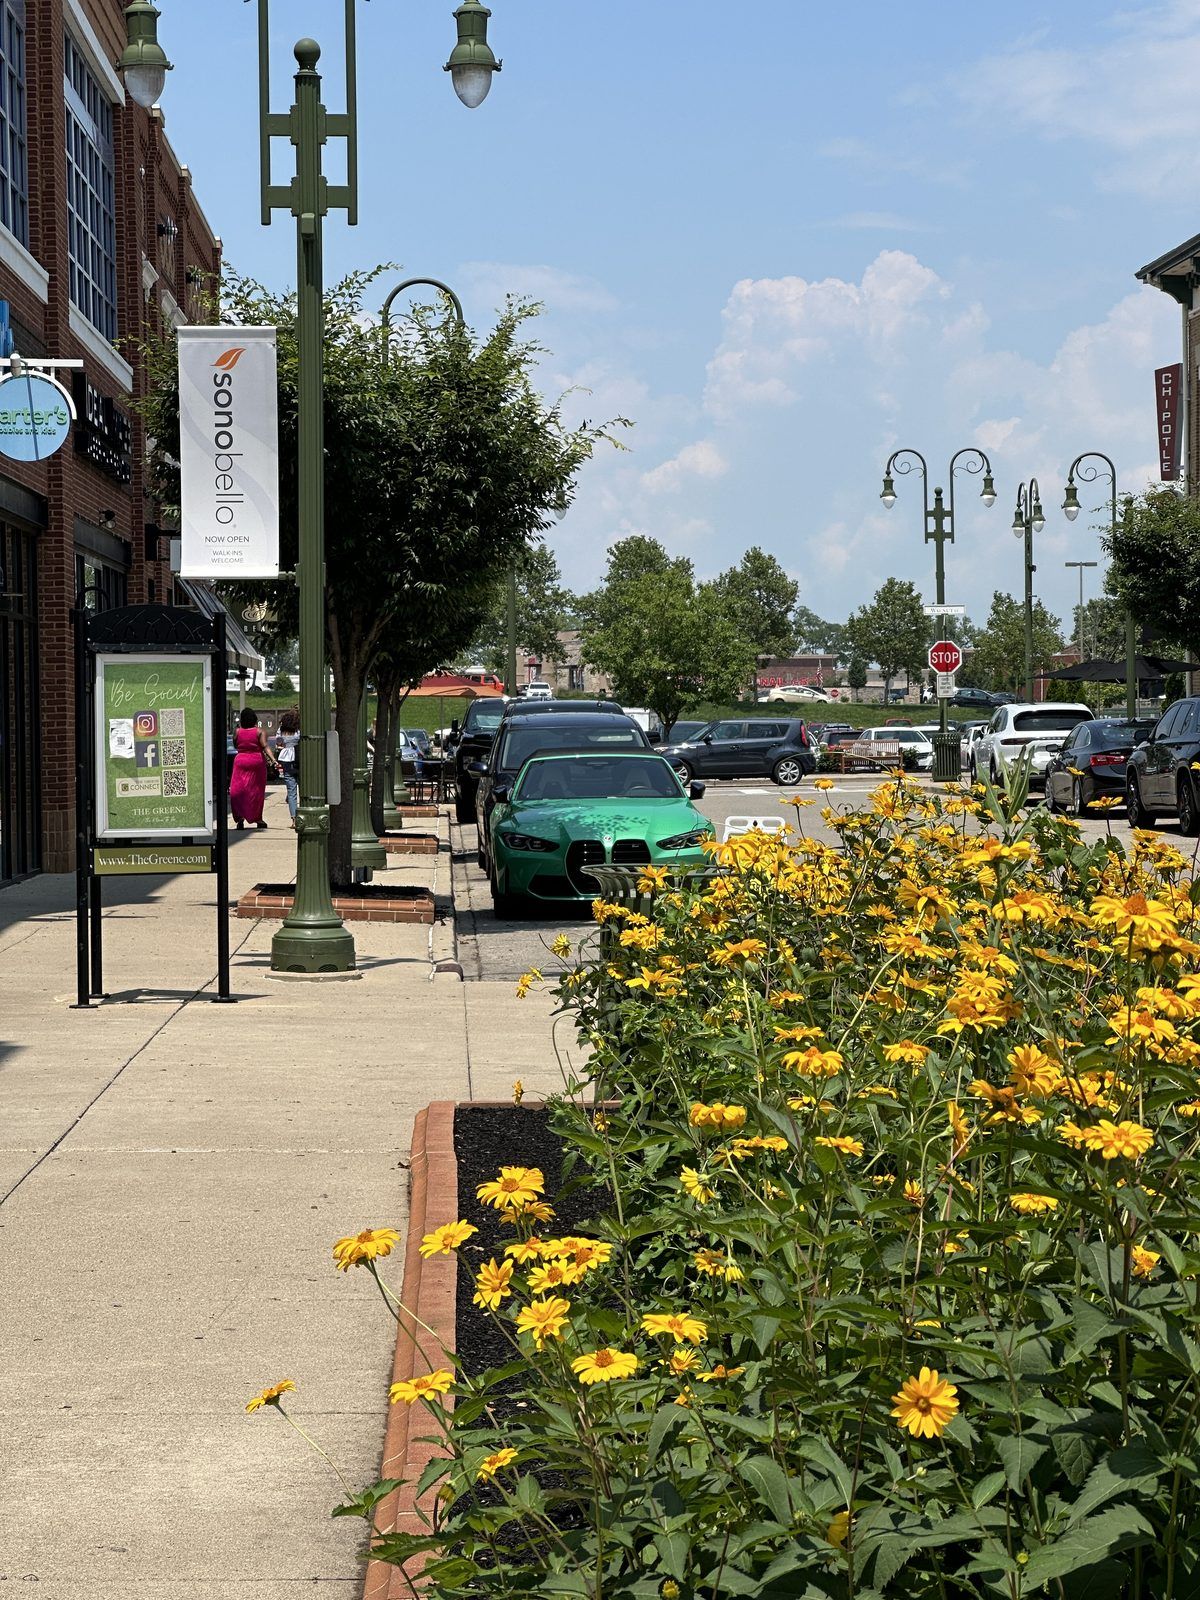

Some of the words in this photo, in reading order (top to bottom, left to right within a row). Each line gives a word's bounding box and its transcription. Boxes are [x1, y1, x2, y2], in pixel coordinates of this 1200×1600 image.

[0, 406, 68, 426] arter's
[1161, 373, 1172, 472] CHIPOTLE
[213, 373, 244, 524] sonobello
[931, 651, 959, 664] STOP
[110, 678, 135, 708] Be
[143, 673, 199, 707] Social
[132, 808, 151, 816] THE
[152, 806, 187, 815] GREENE
[98, 854, 207, 865] www.TheGreene.com
